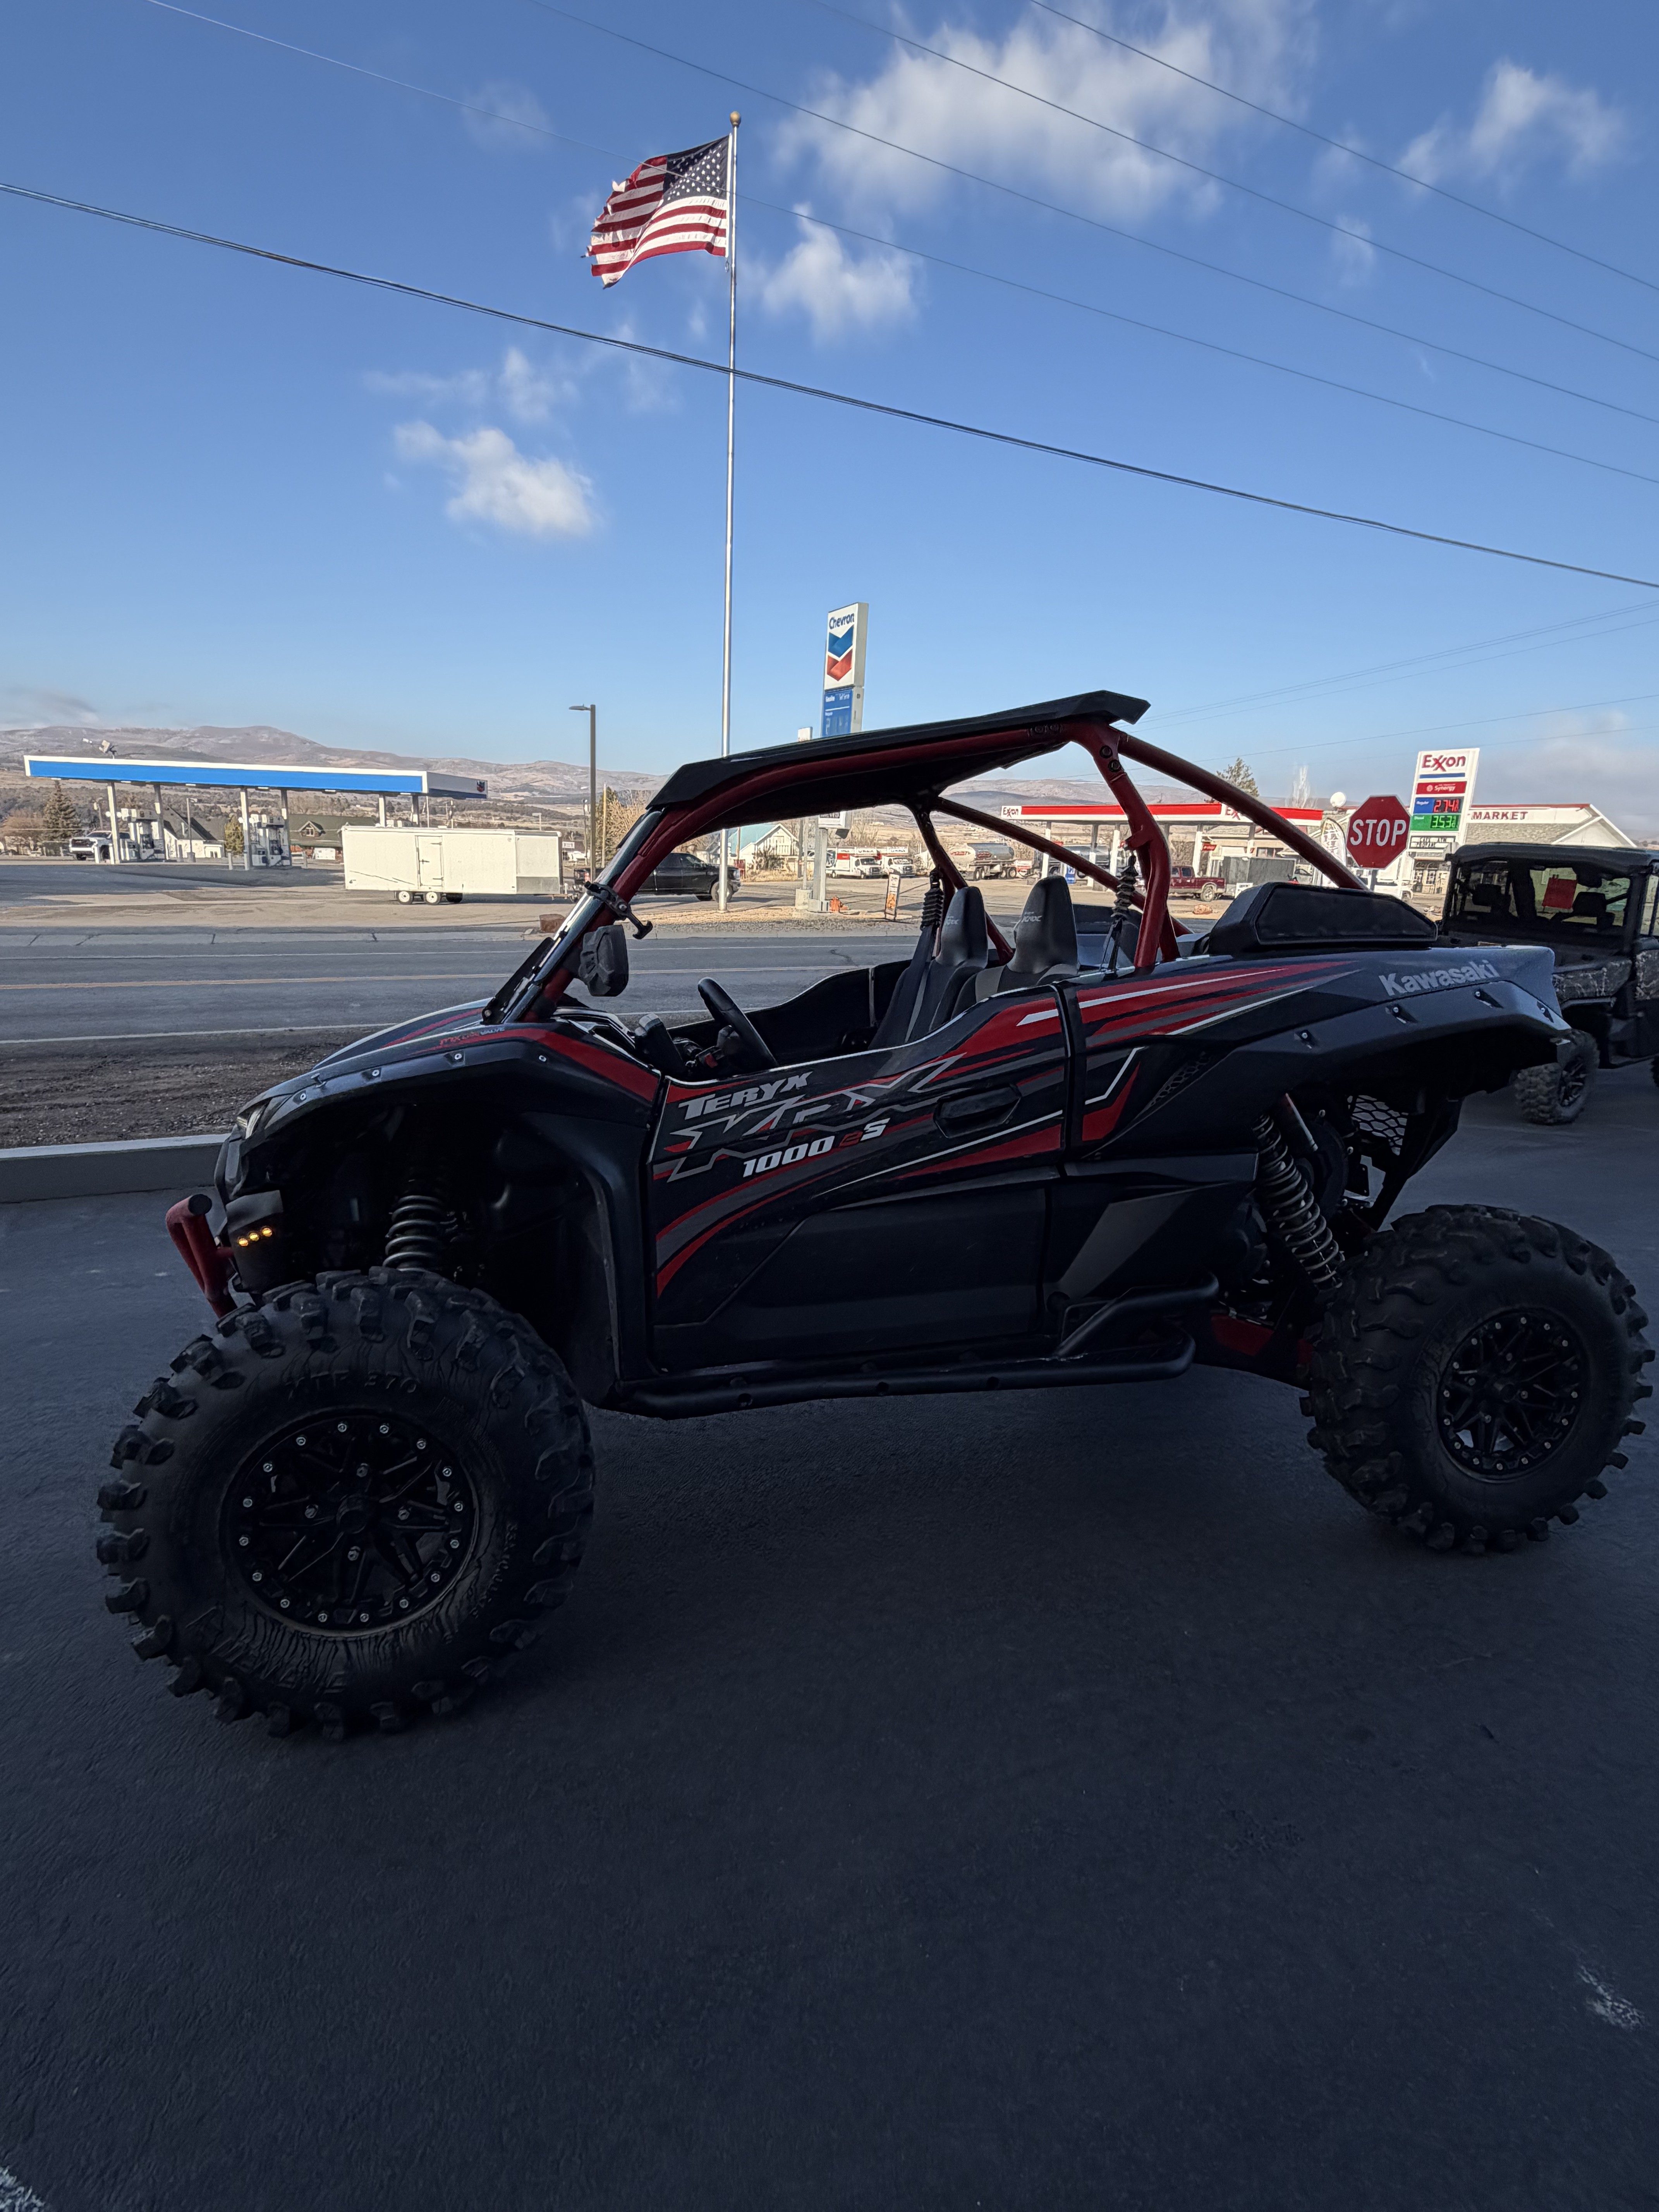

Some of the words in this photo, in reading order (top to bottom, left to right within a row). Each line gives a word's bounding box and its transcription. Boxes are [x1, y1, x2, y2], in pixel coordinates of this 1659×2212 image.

[829, 613, 854, 629] Chevron
[1422, 754, 1466, 772] Exxon
[1003, 807, 1019, 818] Exxon
[1471, 811, 1528, 820] MARKET
[1350, 819, 1406, 847] STOP
[1378, 960, 1501, 997] Kawasaki
[678, 1071, 813, 1120] TERYX
[743, 1135, 835, 1178] 1000
